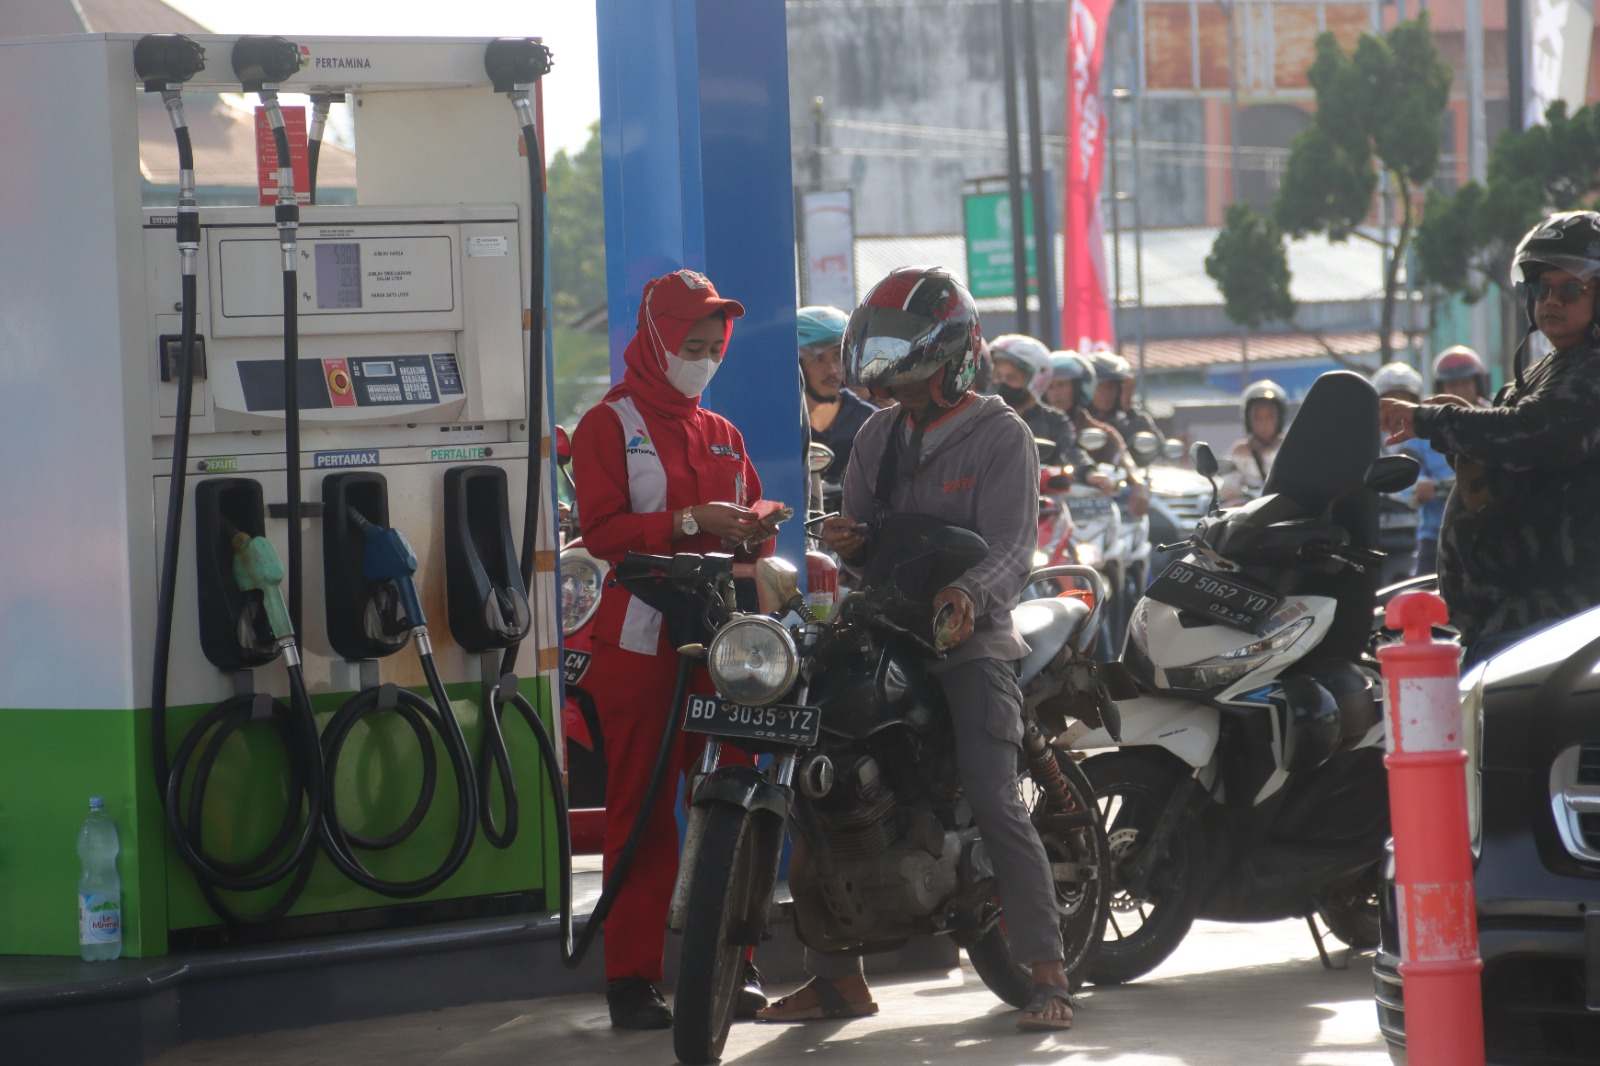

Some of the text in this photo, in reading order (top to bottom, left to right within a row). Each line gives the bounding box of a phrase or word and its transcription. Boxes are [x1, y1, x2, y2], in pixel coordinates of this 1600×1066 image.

[315, 57, 371, 69] PERTAMINA
[317, 453, 377, 467] PERTAMAX
[431, 447, 485, 459] PERTALITE
[1169, 567, 1194, 584] BD
[1244, 594, 1268, 612] YD
[564, 653, 586, 669] CN
[691, 699, 813, 730] BD 3035 YZ
